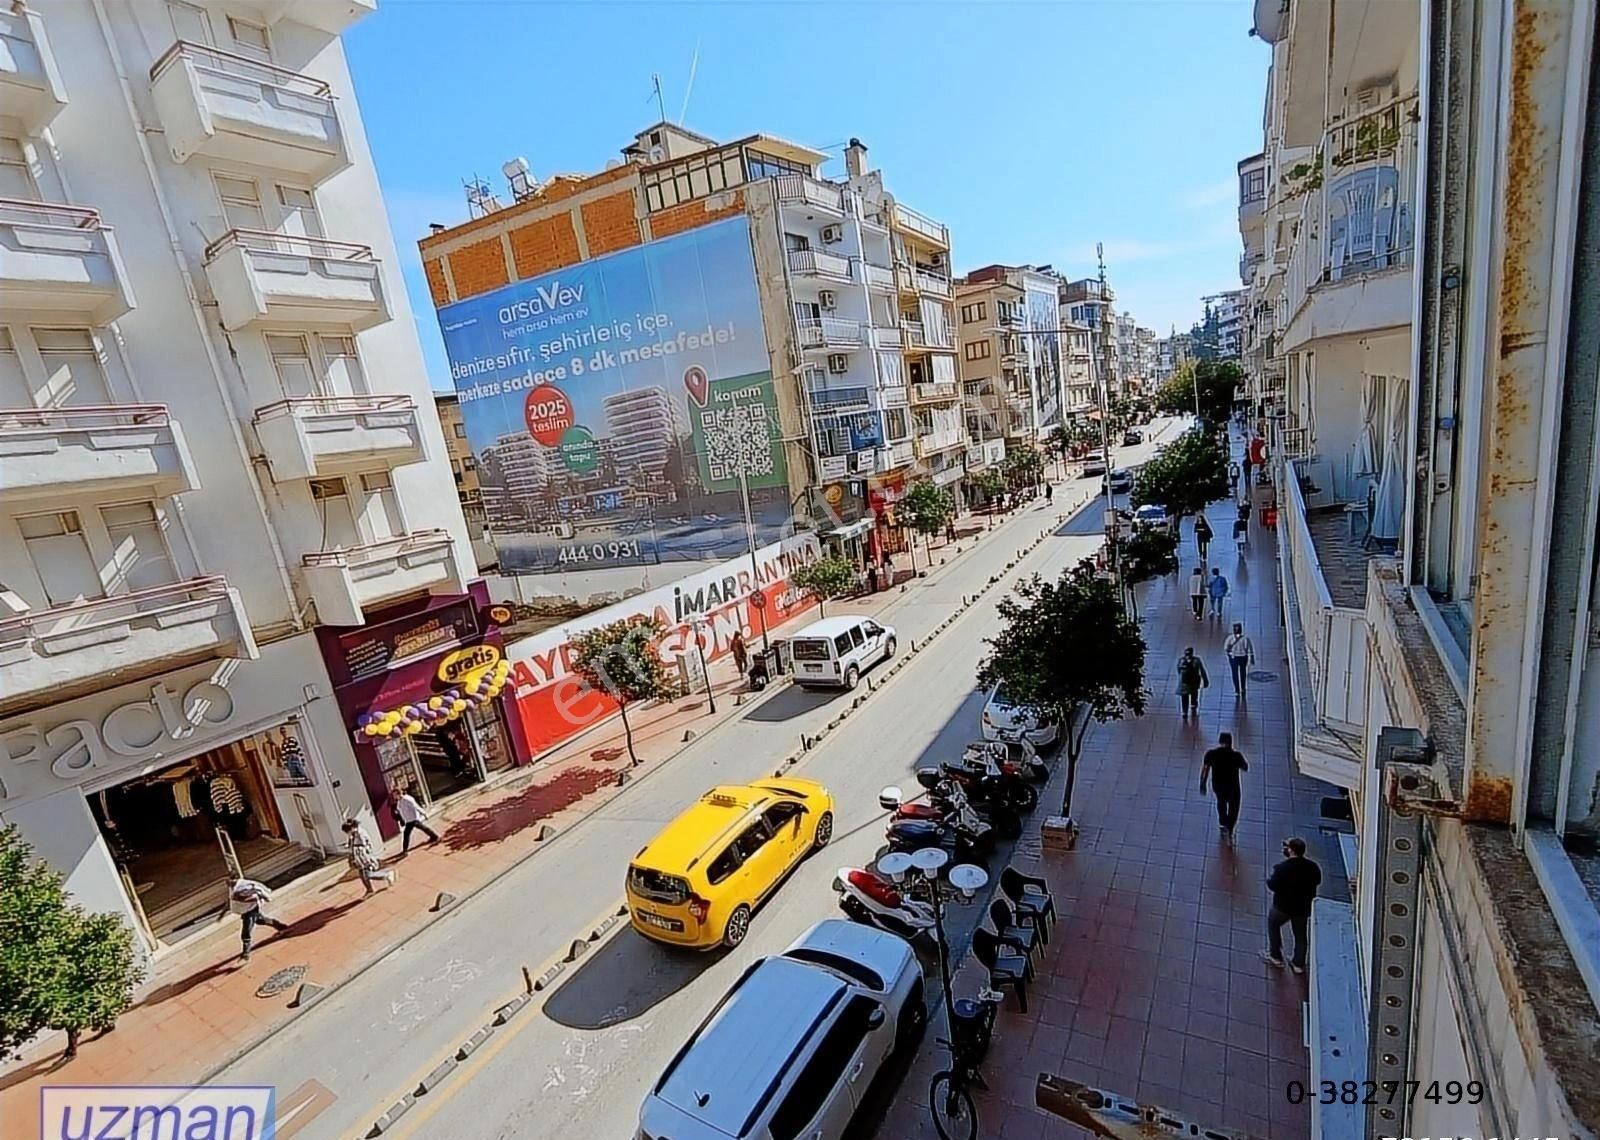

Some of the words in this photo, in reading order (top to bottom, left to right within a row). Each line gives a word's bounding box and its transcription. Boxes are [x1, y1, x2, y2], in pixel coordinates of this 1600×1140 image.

[503, 325, 525, 340] hem
[550, 311, 574, 326] hem
[452, 356, 495, 379] denize
[540, 325, 610, 363] şehirle
[613, 319, 632, 342] iç
[636, 313, 673, 336] içe,
[458, 382, 501, 404] merkeze
[502, 366, 567, 393] sadece
[571, 357, 585, 376] 8
[590, 350, 616, 372] dk
[620, 321, 736, 365] mesafede!
[528, 399, 566, 420] 2025
[714, 386, 761, 403] konum
[533, 417, 569, 433] teslim
[559, 545, 589, 564] 444
[608, 539, 640, 559] 931
[674, 575, 738, 624] İMAR
[658, 600, 752, 667] SON!
[445, 646, 494, 680] gratis
